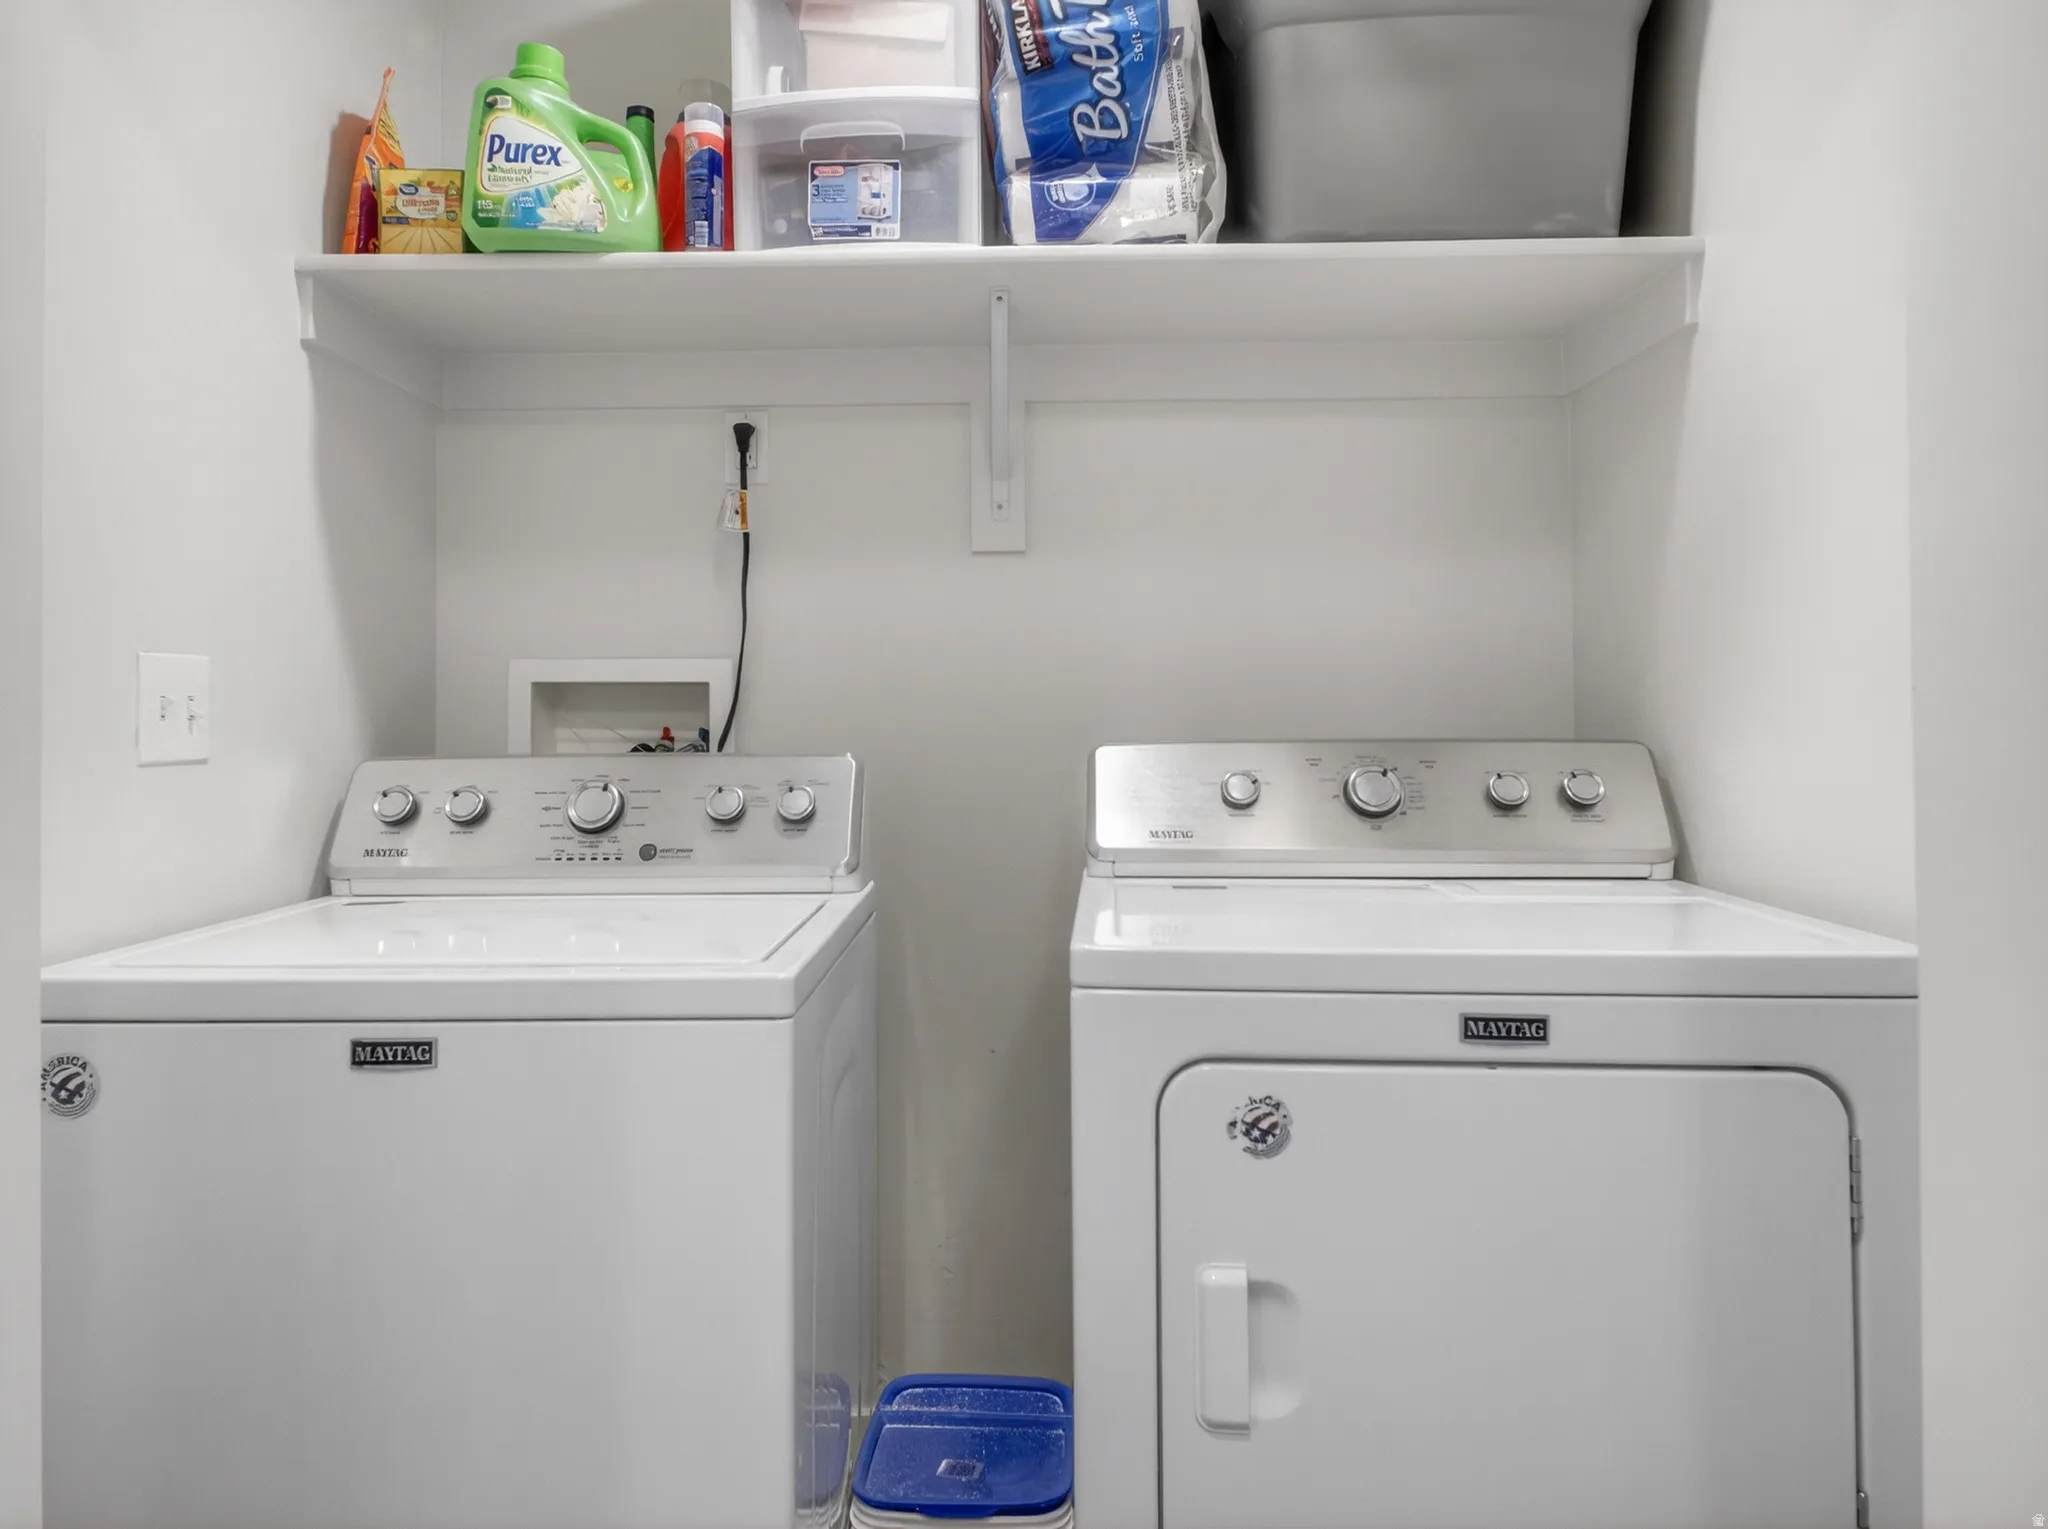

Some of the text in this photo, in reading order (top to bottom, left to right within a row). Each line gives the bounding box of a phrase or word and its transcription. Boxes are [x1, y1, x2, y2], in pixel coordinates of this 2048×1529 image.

[1130, 31, 1144, 62] Soft
[1059, 10, 1128, 146] Bath
[487, 134, 562, 167] Purex
[812, 184, 820, 197] 3
[1149, 830, 1194, 839] MAYTAG
[362, 848, 409, 857] MAYTAG
[1467, 1020, 1545, 1037] MAYTAG
[355, 1045, 430, 1061] MAYTAG
